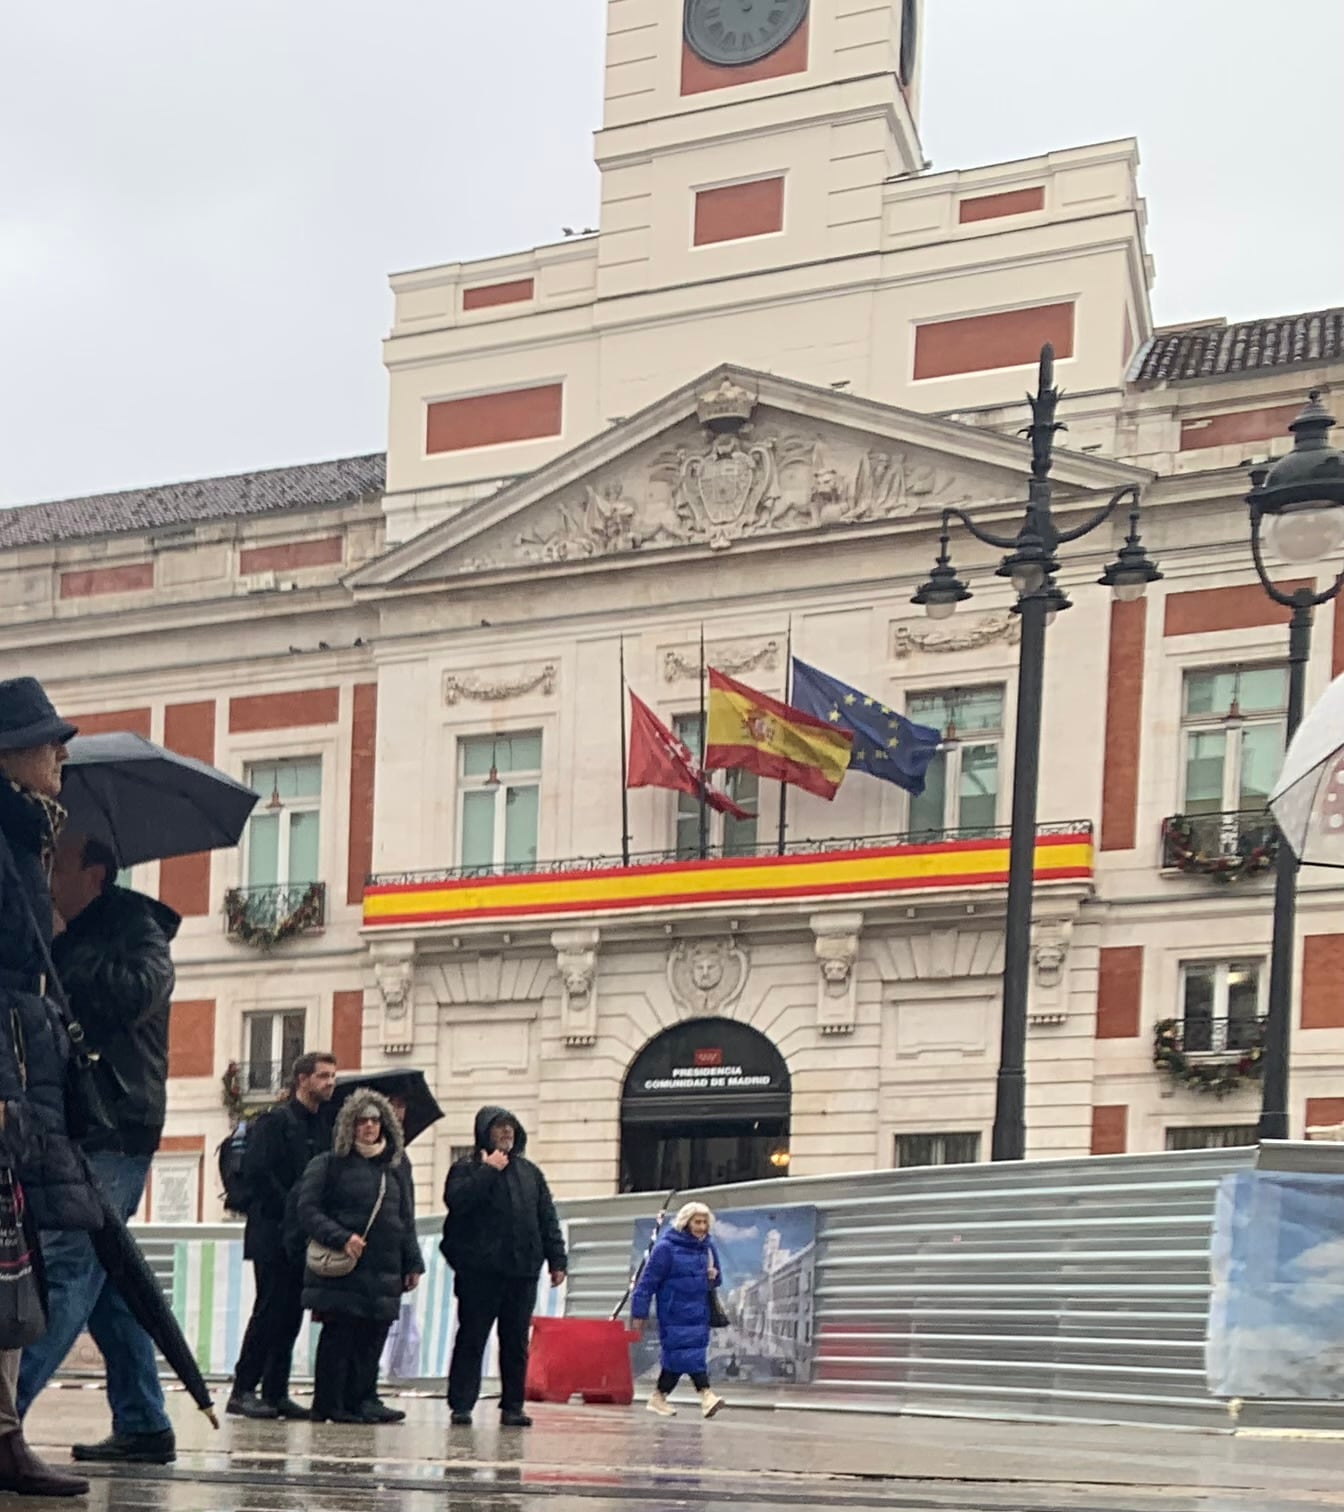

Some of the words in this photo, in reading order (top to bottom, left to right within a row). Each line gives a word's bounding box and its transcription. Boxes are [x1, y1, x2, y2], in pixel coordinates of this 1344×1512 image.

[672, 1066, 742, 1077] PRESIDENCIA
[644, 1078, 708, 1089] COMUNIDAD
[710, 1077, 725, 1086] DE
[727, 1075, 771, 1086] MADRID
